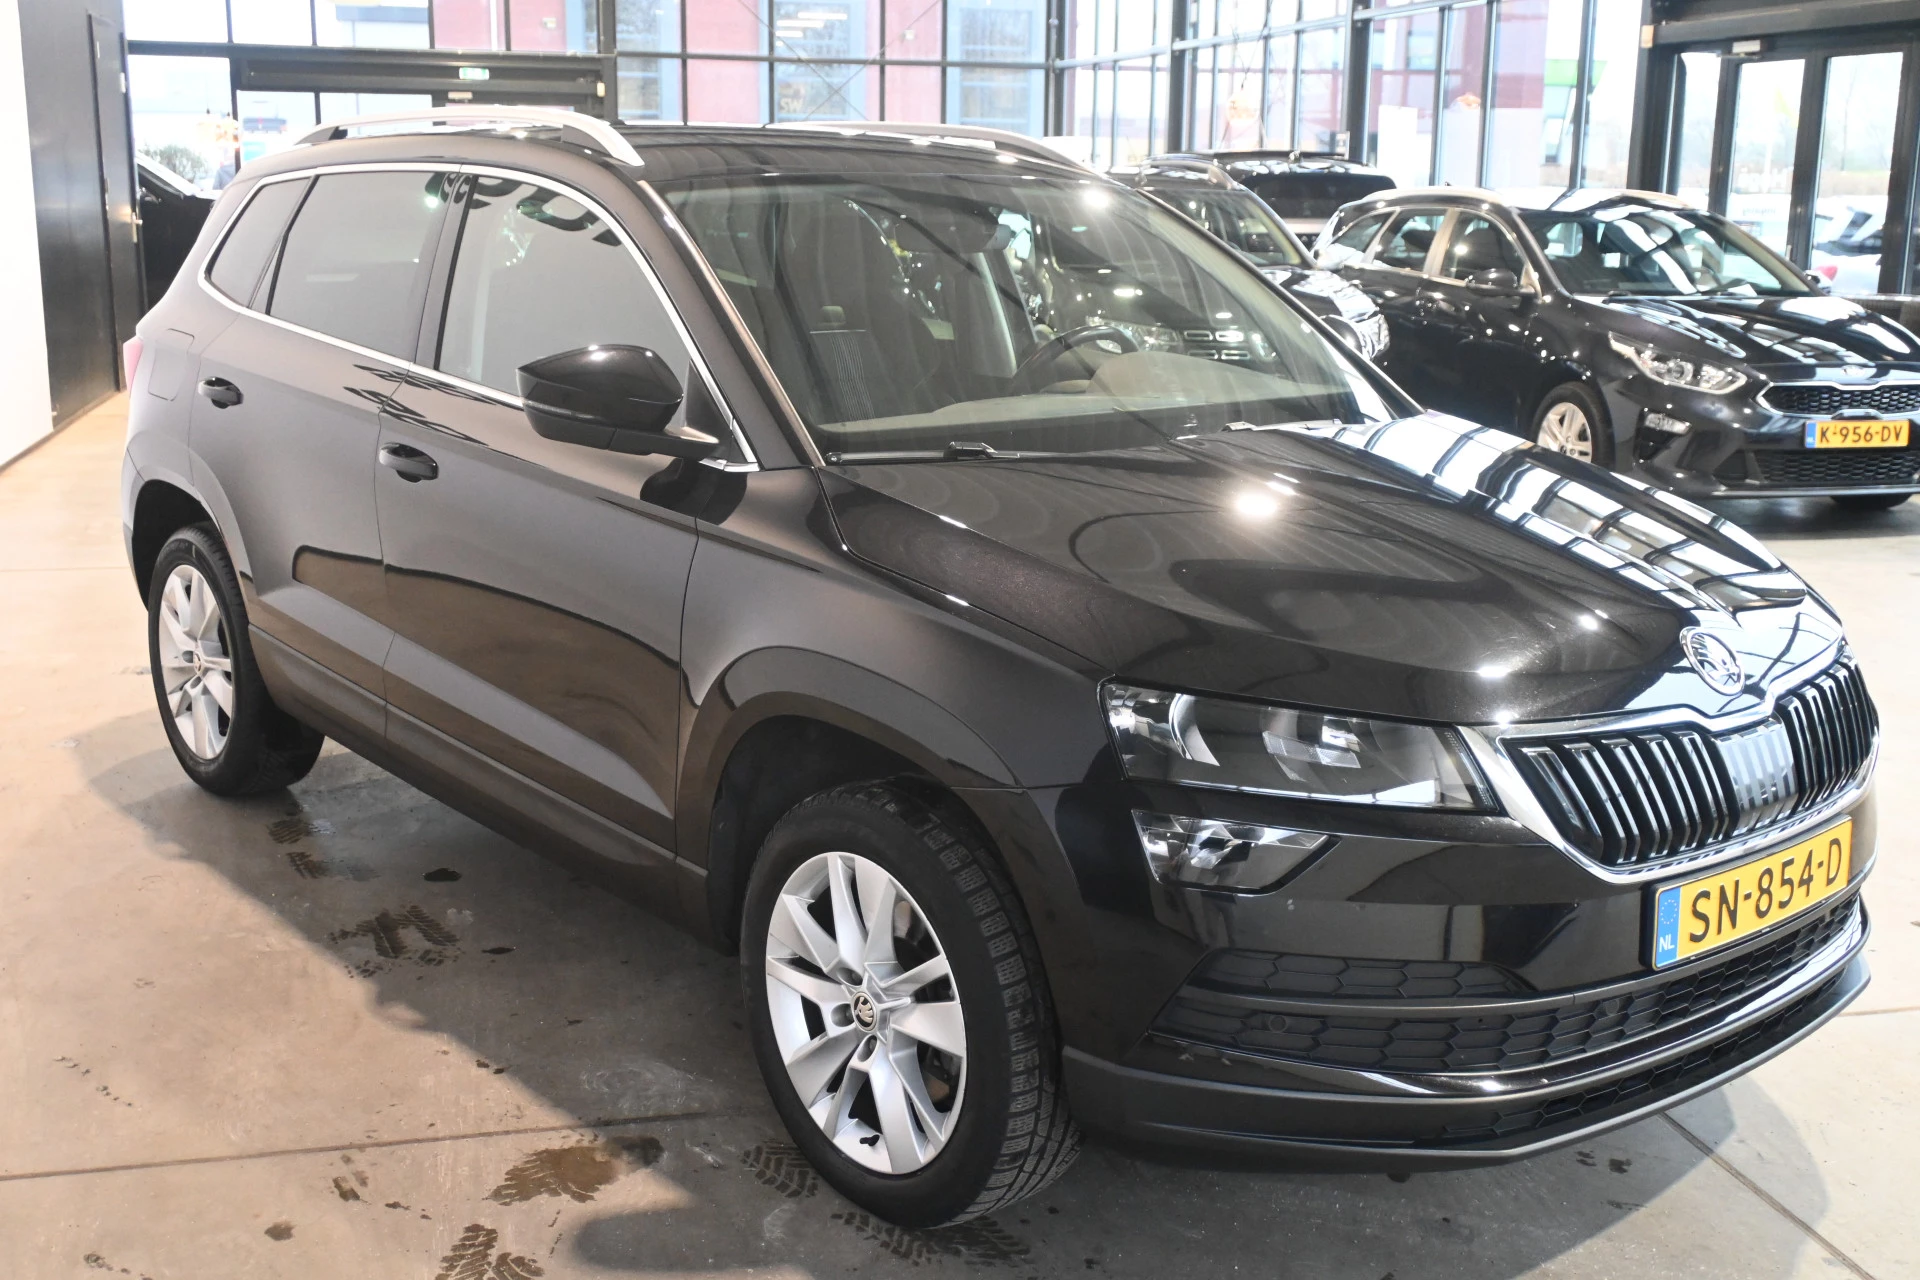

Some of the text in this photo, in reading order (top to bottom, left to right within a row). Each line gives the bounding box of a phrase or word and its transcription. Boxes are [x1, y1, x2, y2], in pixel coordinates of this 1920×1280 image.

[1820, 425, 1903, 443] K-956-DV
[1689, 837, 1843, 943] SN-854-D
[1658, 933, 1675, 953] NL
